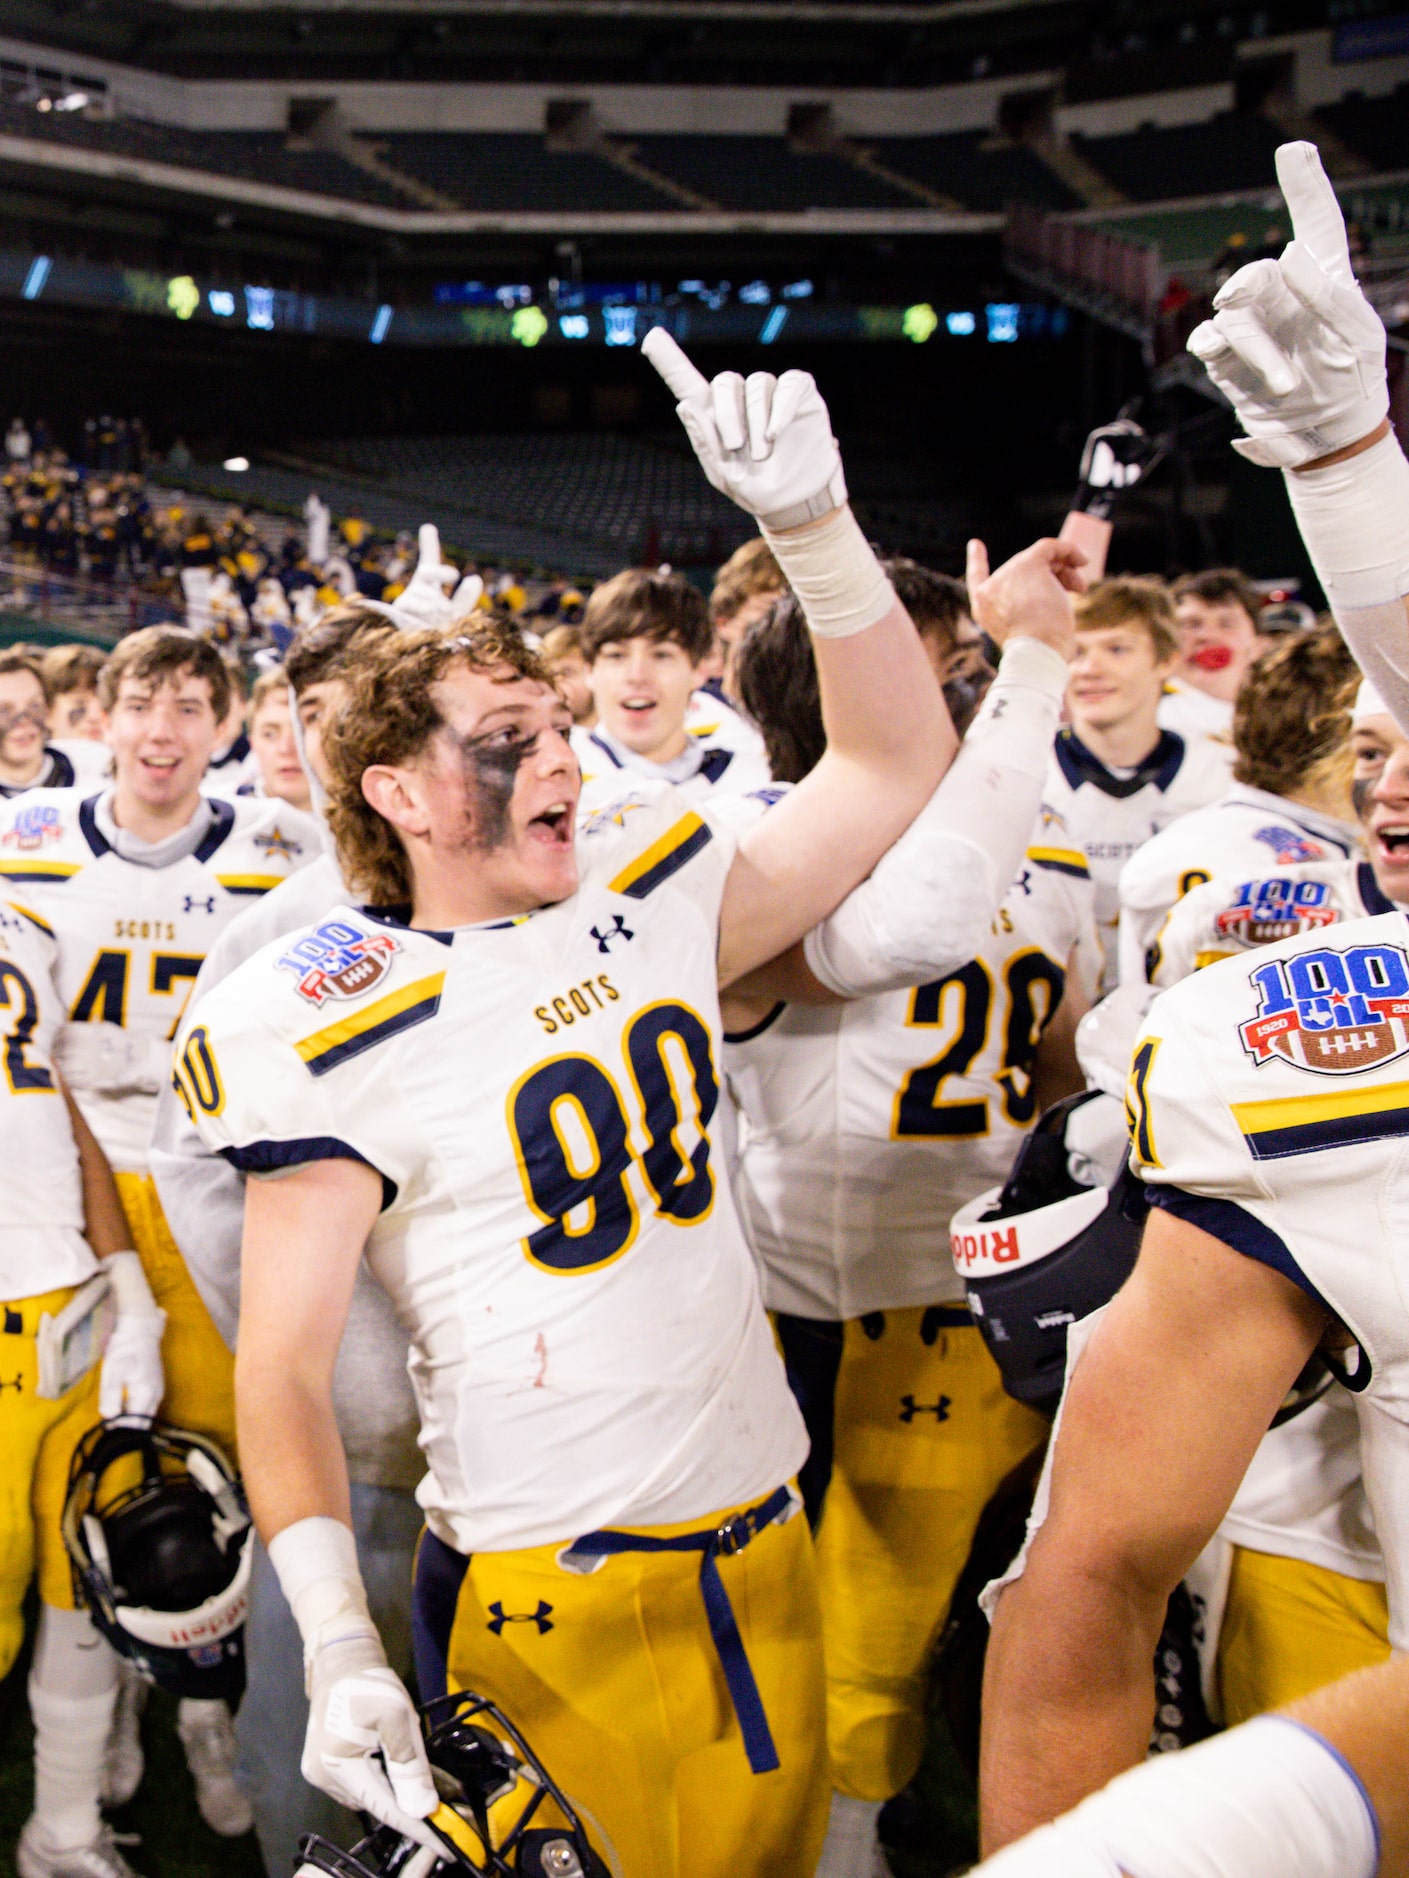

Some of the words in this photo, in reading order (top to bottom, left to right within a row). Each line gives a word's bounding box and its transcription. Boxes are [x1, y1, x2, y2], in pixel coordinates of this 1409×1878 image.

[1232, 878, 1328, 908] 100
[114, 918, 177, 942] SCOTS
[277, 922, 365, 977] 100
[68, 946, 208, 1042] 47
[533, 973, 621, 1034] SCOTS
[1255, 946, 1409, 1016] 100
[1255, 1017, 1289, 1038] 1920
[1297, 994, 1383, 1031] UIL
[1123, 1034, 1166, 1169] 1
[504, 997, 722, 1278] 90
